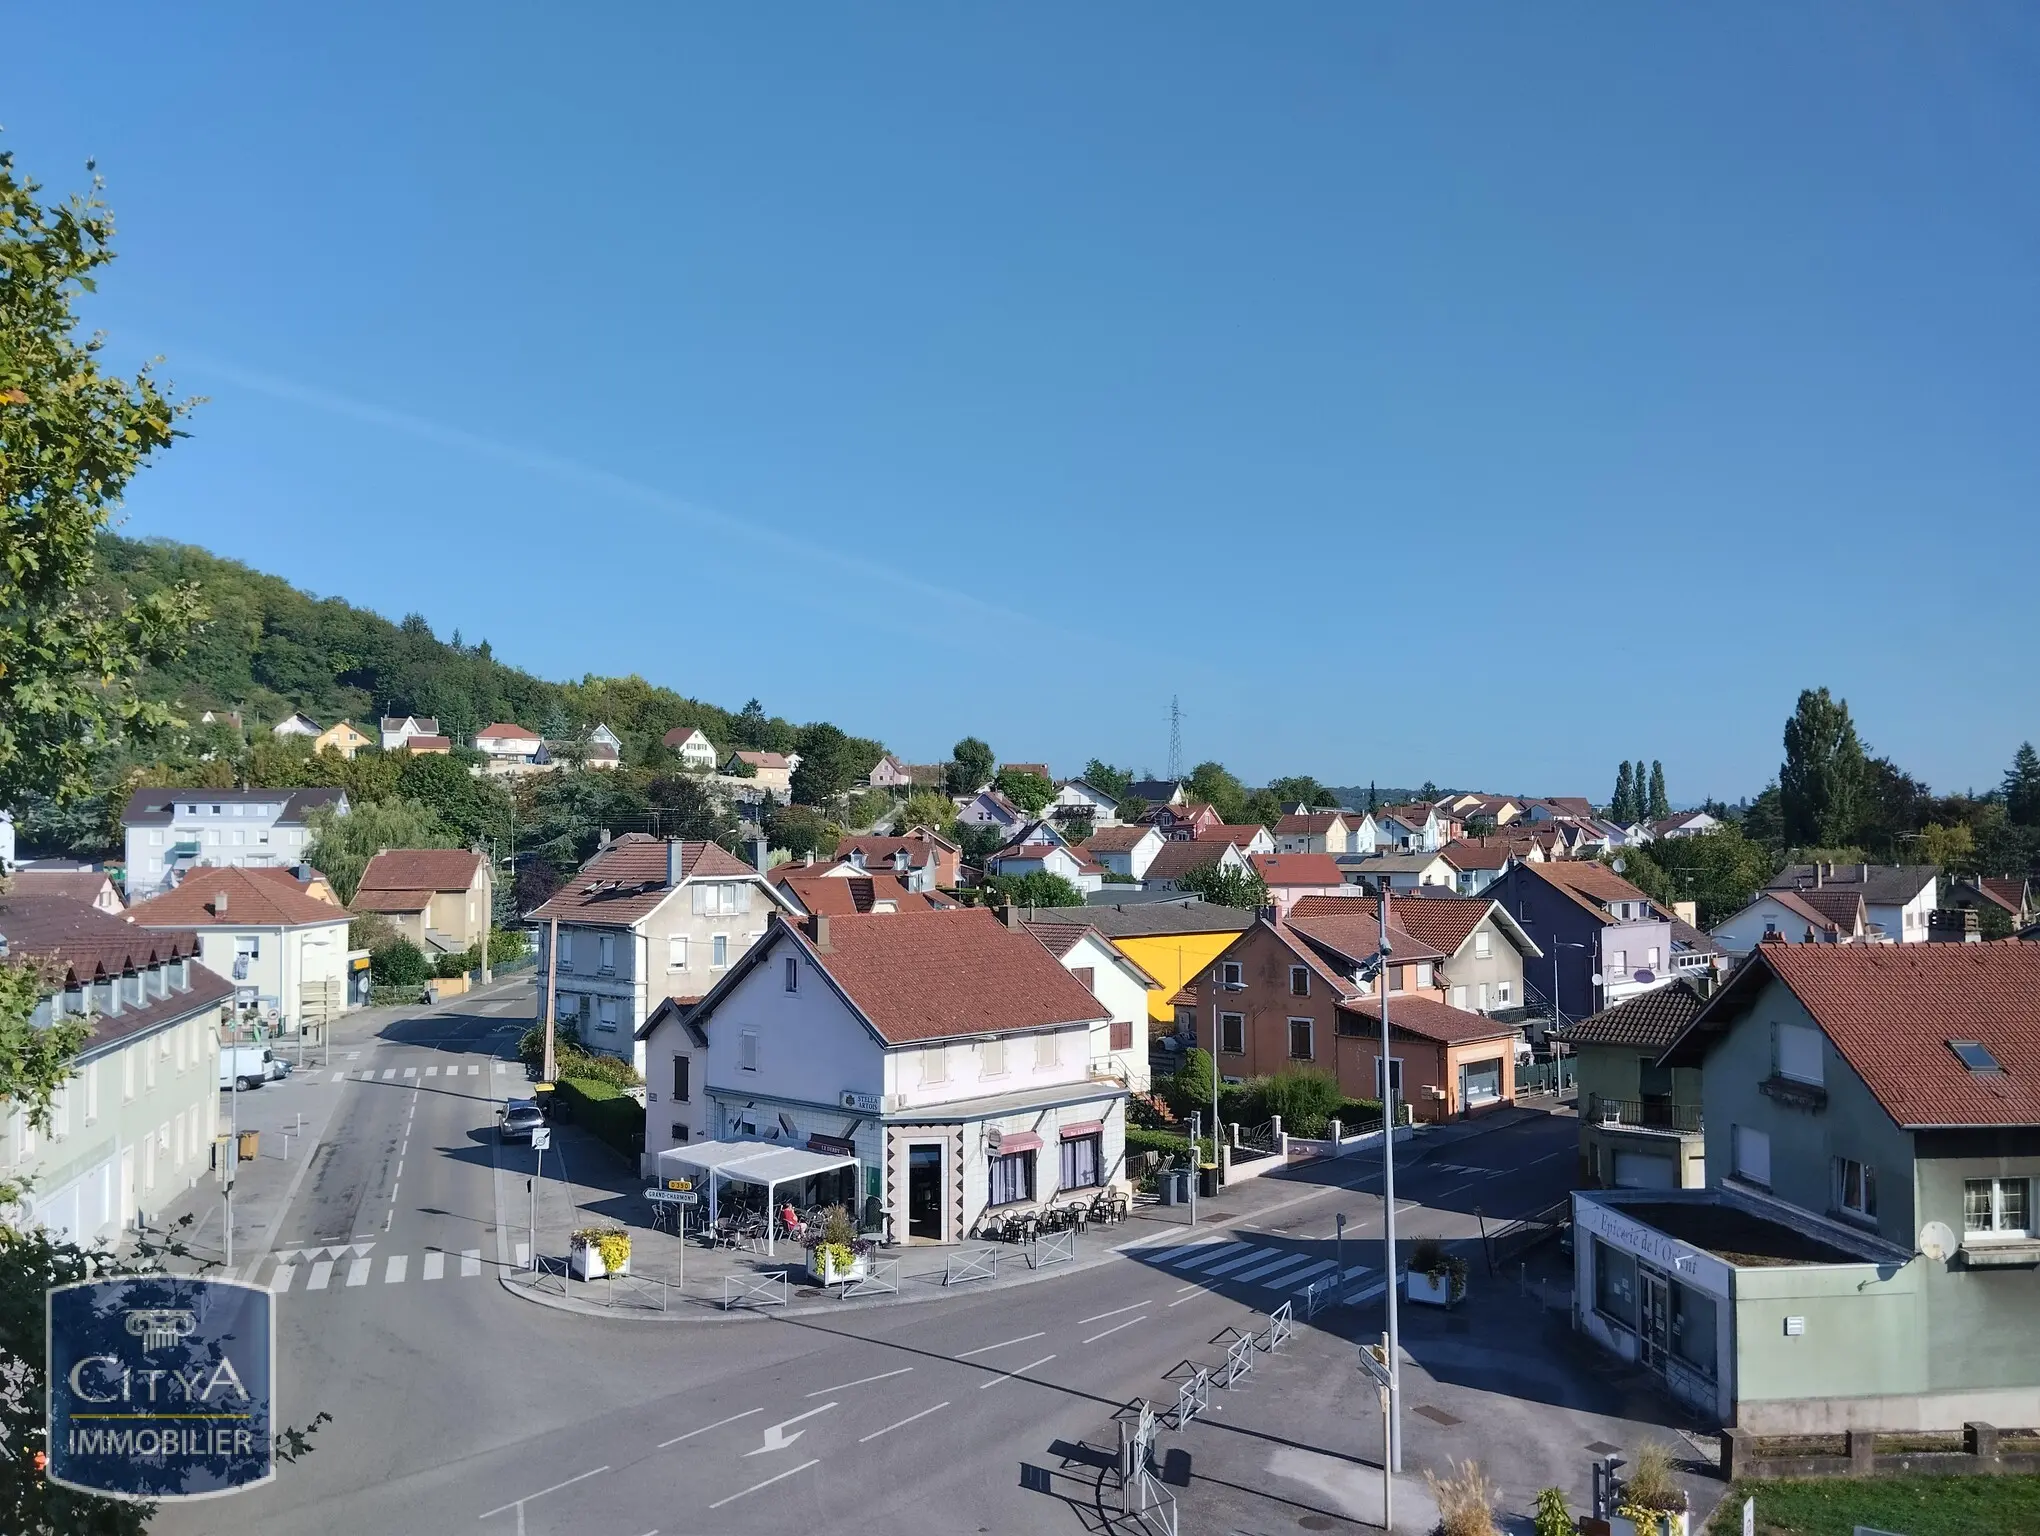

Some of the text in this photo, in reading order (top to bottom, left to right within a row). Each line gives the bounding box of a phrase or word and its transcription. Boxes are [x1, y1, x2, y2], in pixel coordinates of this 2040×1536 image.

[857, 1095, 878, 1103] STELLA
[859, 1102, 878, 1110] ARTOIS
[648, 1191, 694, 1201] GRAND-CHARMONT
[1601, 1213, 1639, 1246] Epicerie
[1641, 1233, 1652, 1253] de
